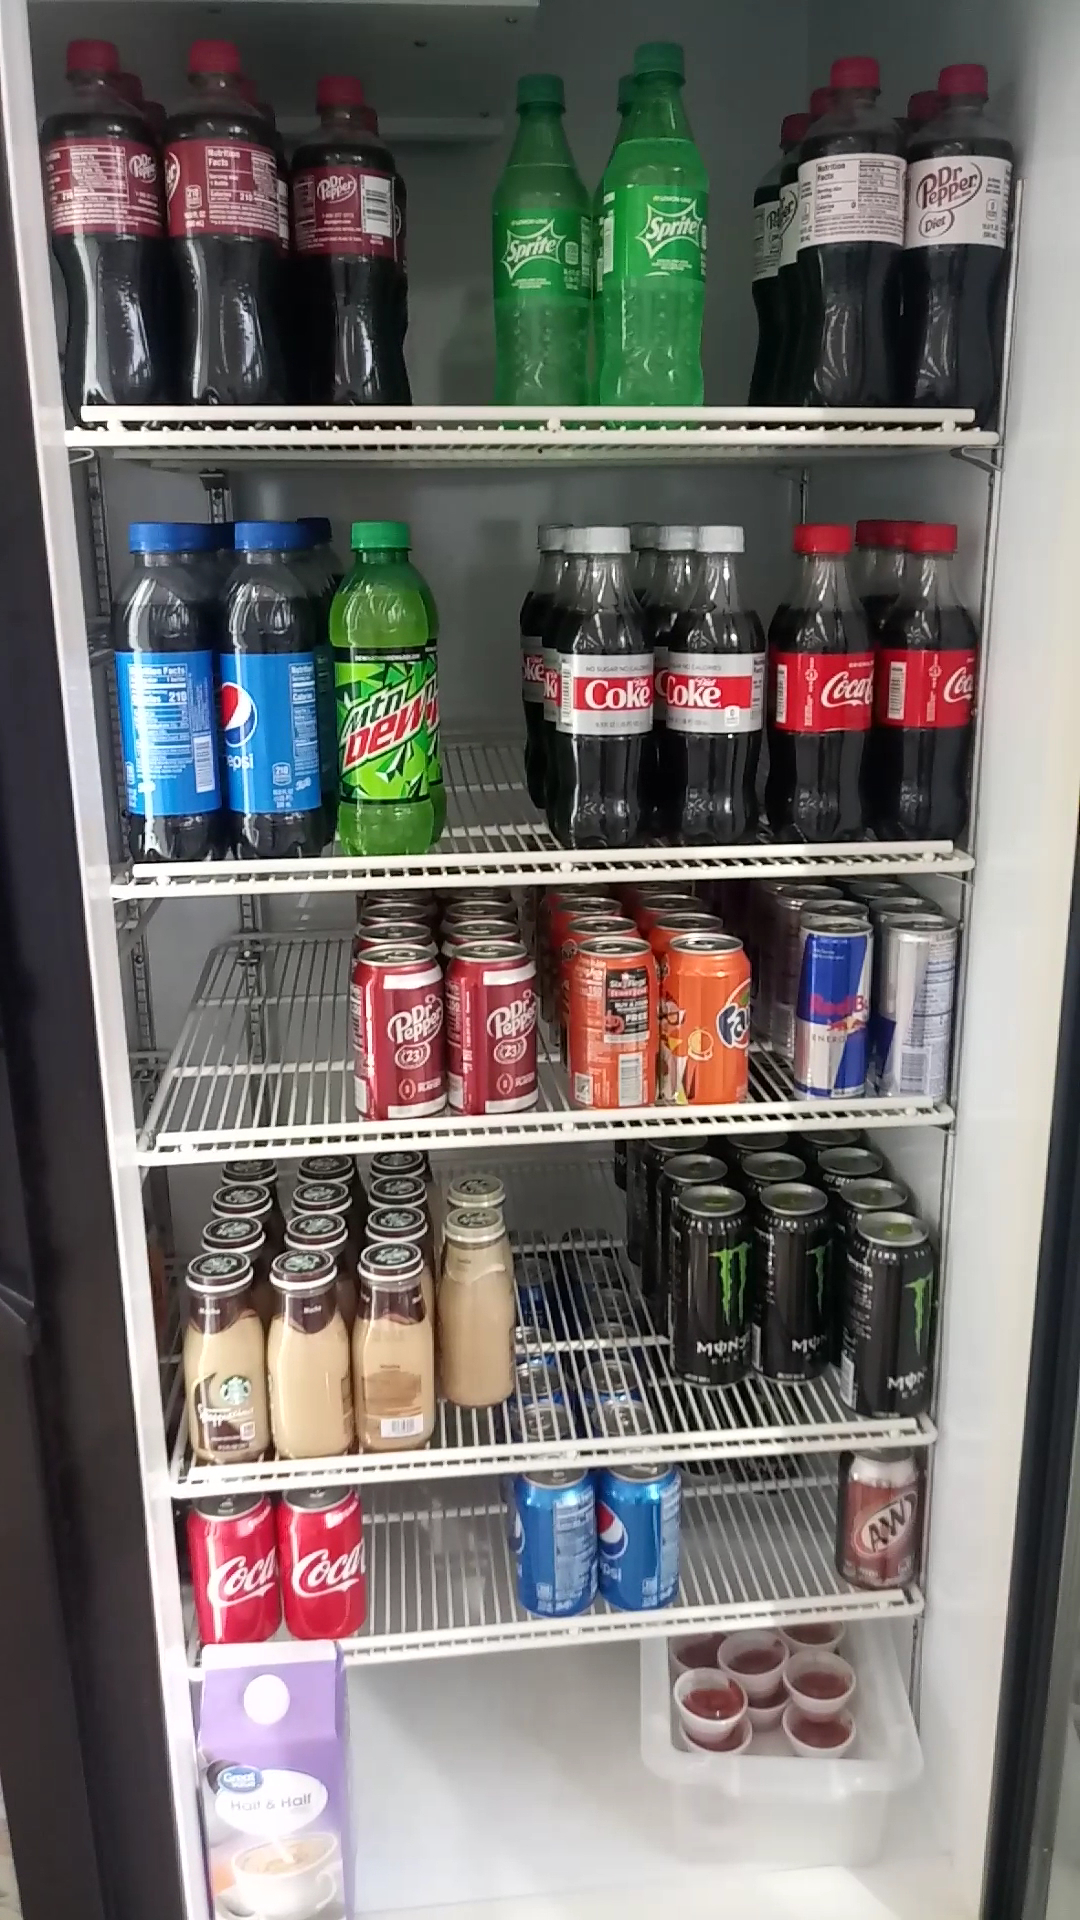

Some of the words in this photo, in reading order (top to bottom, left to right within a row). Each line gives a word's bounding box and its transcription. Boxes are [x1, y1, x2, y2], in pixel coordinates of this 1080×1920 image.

[329, 175, 345, 188] Dr
[938, 166, 963, 188] Dr
[319, 179, 353, 201] Pepper
[919, 173, 978, 210] Pepper
[646, 215, 698, 241] Sprite
[925, 215, 946, 233] Diet
[507, 236, 556, 263] Sprite
[584, 679, 651, 710] Coke
[667, 674, 722, 709] Coke
[411, 1003, 433, 1022] Dr
[509, 998, 532, 1019] Dr
[394, 1006, 442, 1044] Pepper
[407, 1049, 421, 1062] 23
[504, 1044, 518, 1056] 23
[266, 1800, 276, 1810] &
[280, 1791, 313, 1809] Half
